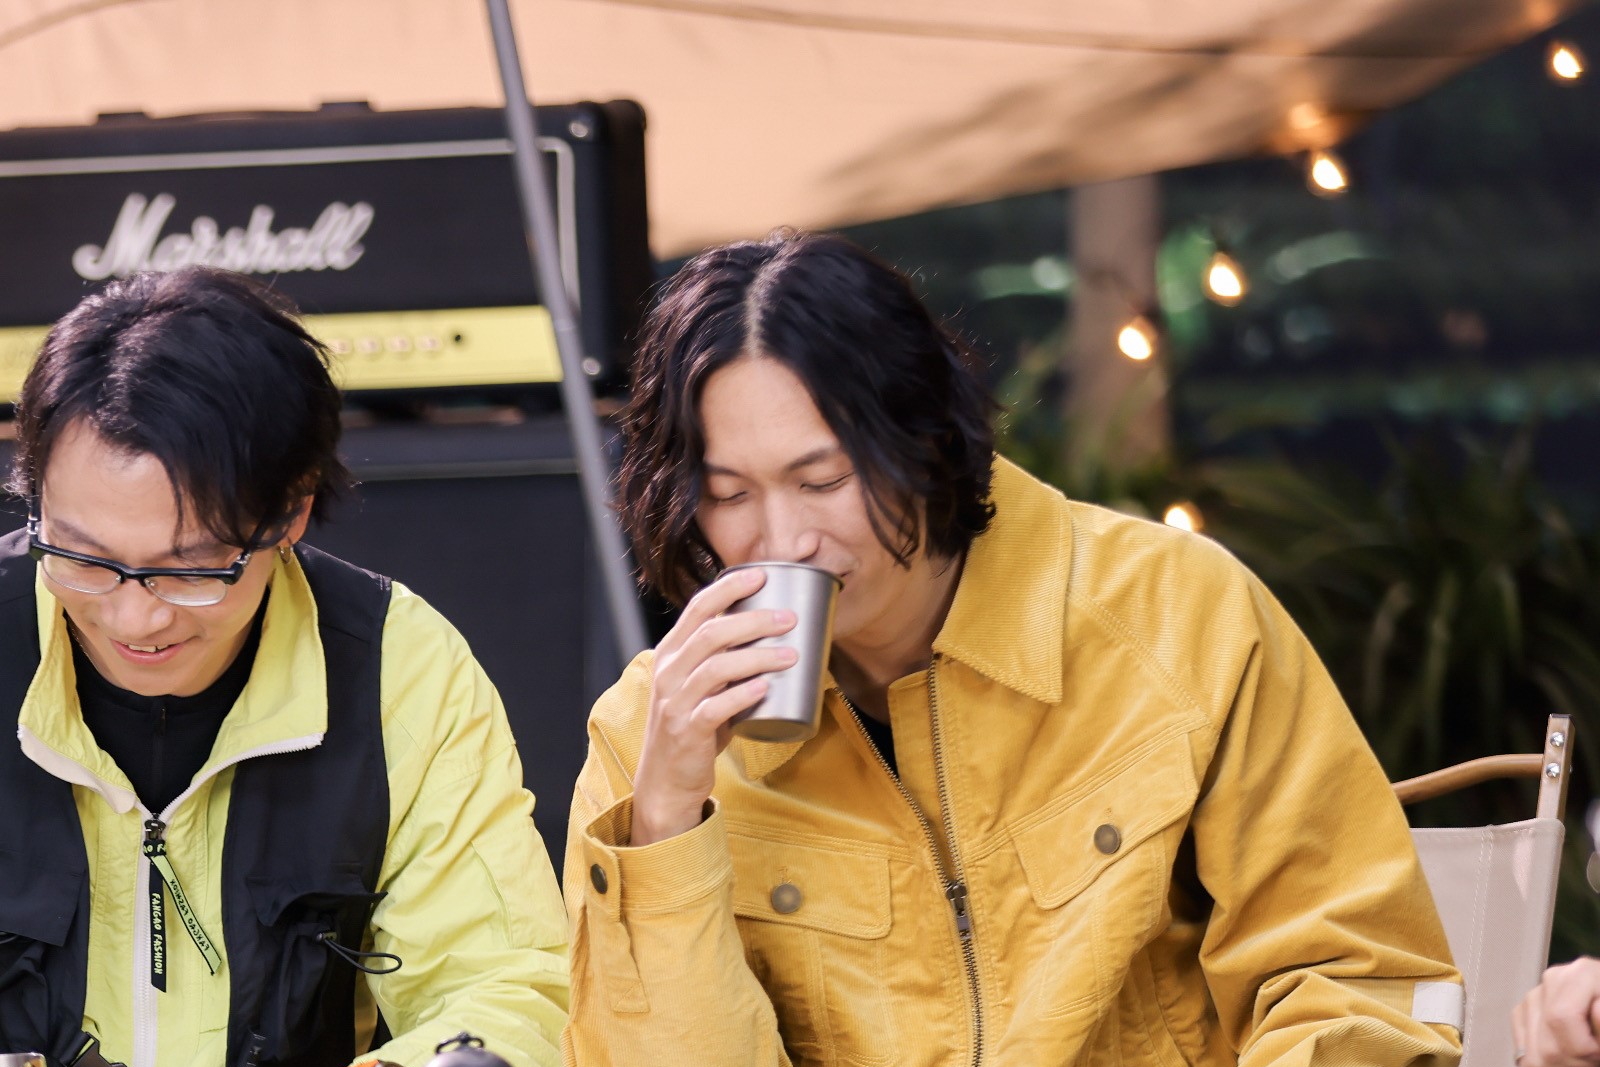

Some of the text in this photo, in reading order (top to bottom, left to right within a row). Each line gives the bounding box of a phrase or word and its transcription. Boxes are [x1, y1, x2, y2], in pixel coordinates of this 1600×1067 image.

[72, 192, 374, 280] Marshall
[151, 892, 163, 974] FANGAO FASHION
